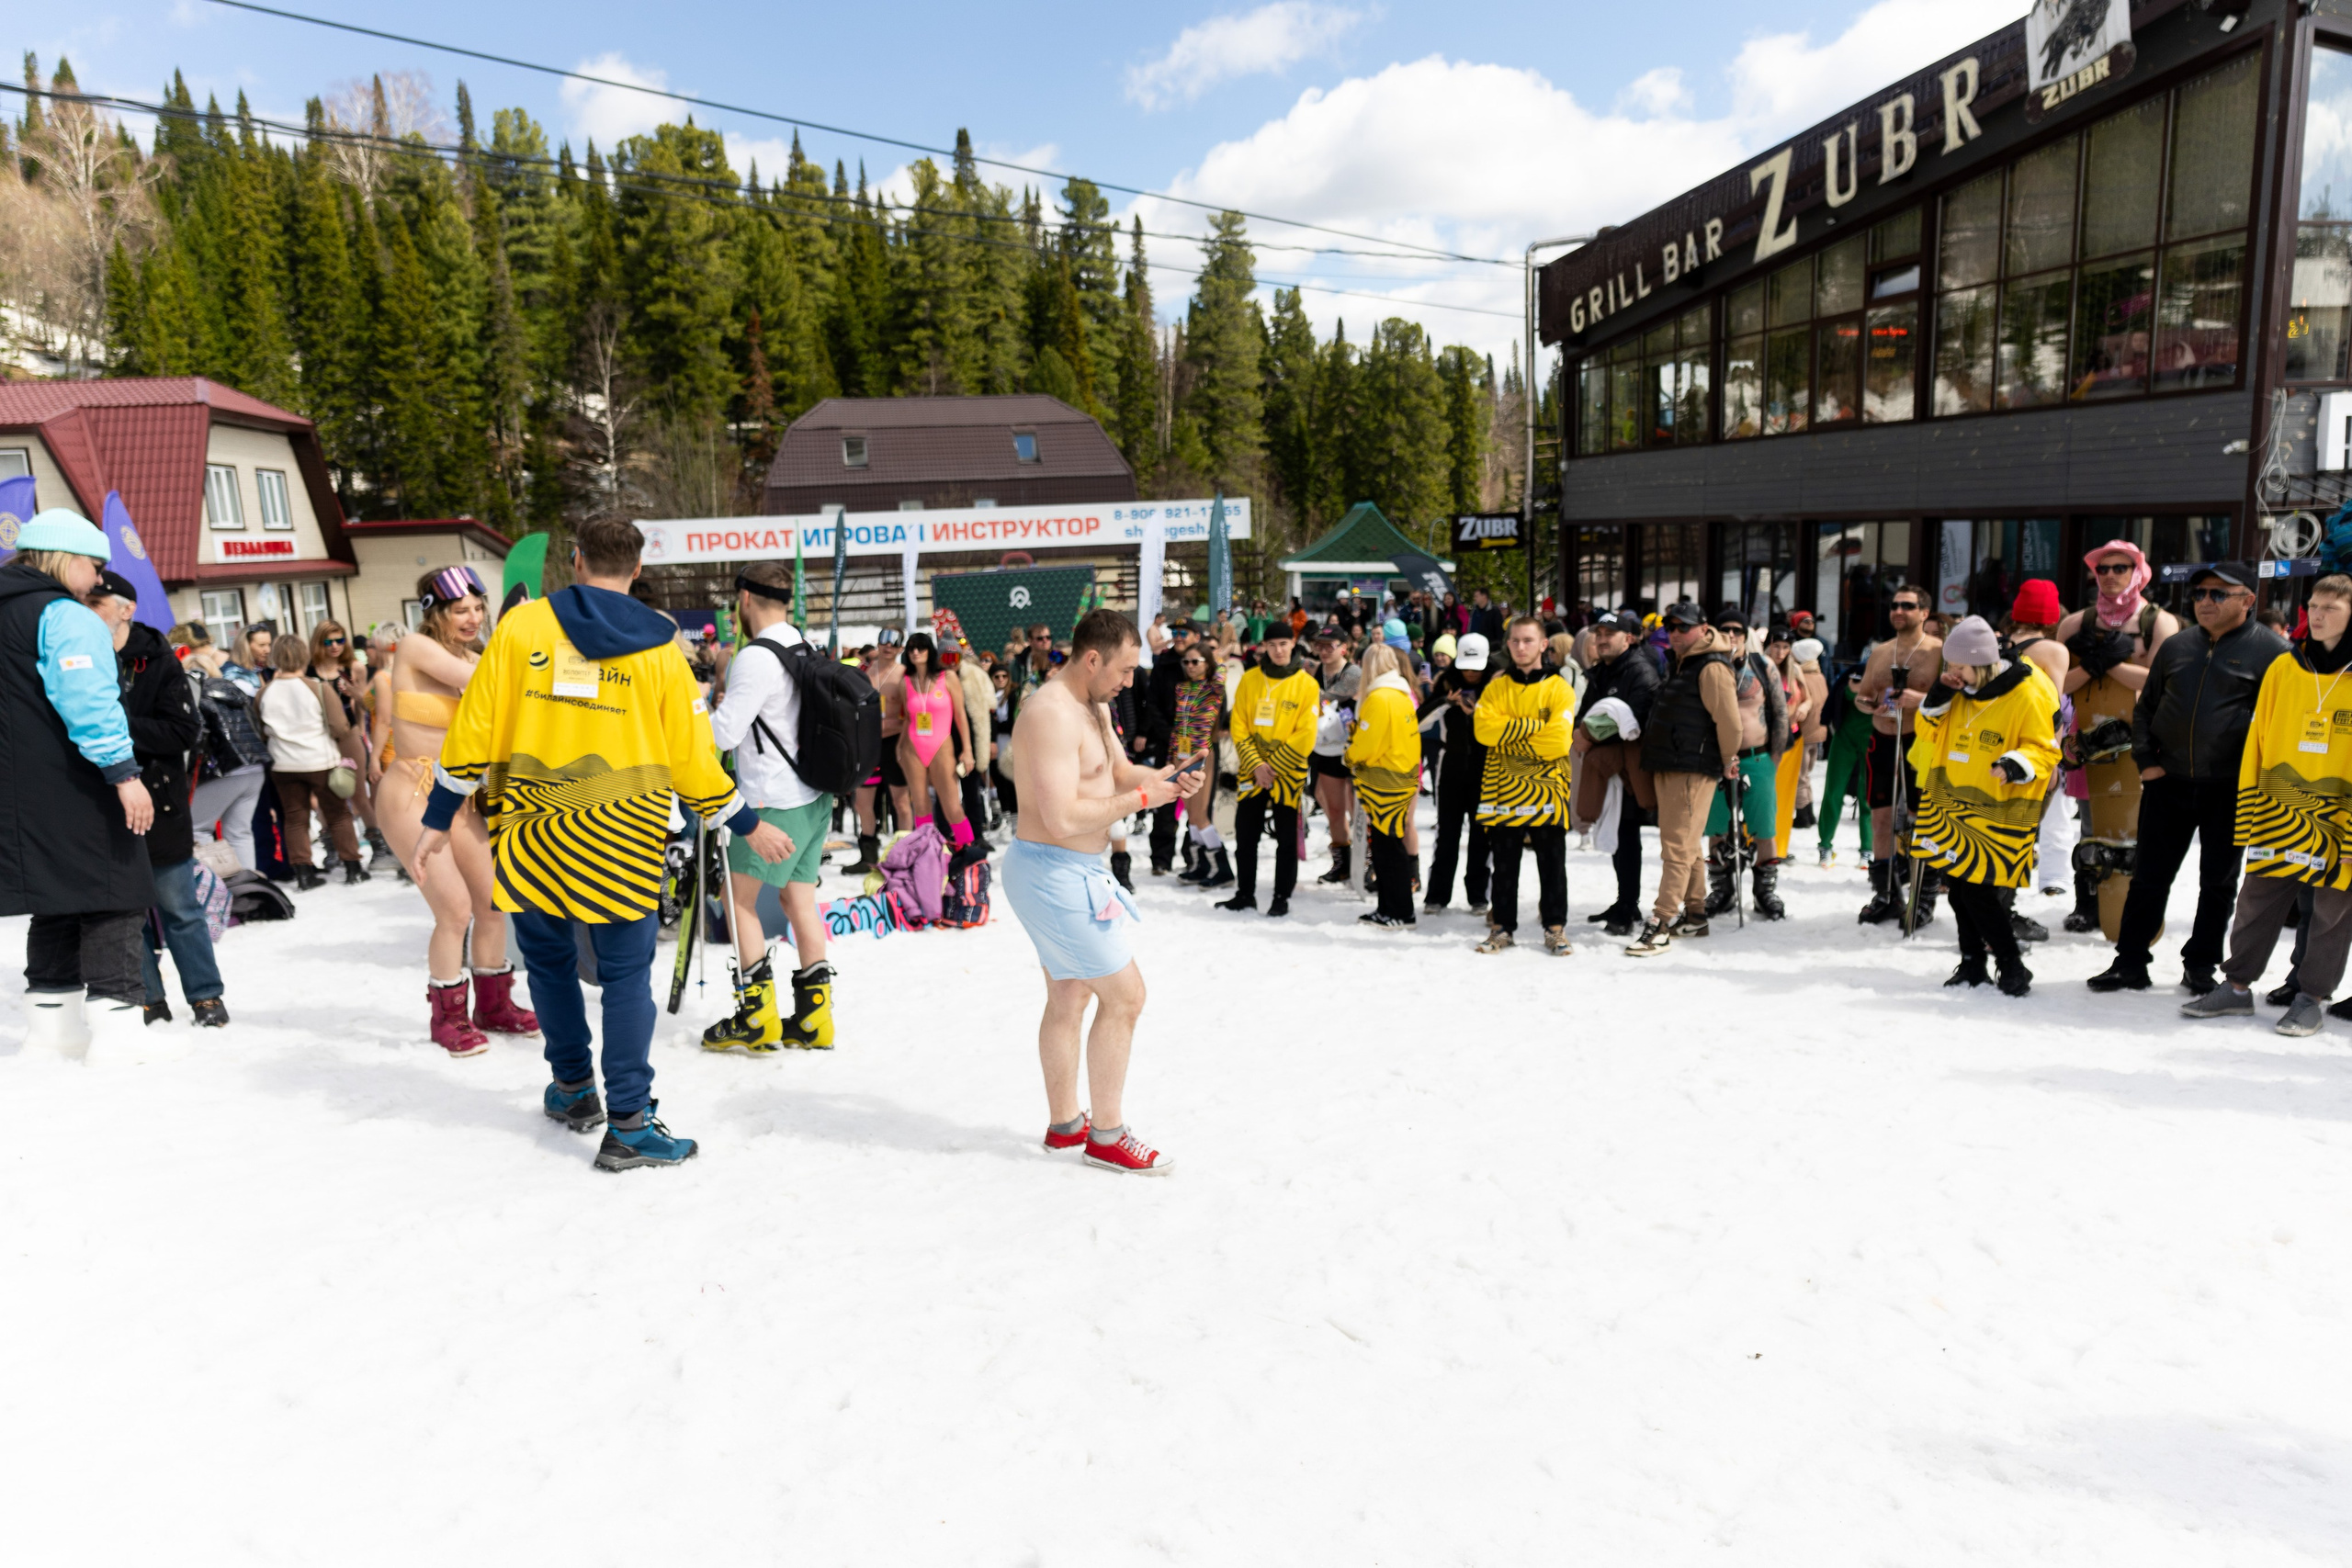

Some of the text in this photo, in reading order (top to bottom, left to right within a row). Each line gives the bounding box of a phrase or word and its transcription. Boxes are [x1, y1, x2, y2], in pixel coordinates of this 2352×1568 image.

[2041, 55, 2110, 110] ZUBR
[1570, 56, 1982, 333] GRILL BAR ZUBR
[686, 529, 794, 552] ПРОКАТ
[933, 516, 1101, 542] ИНСТРУКТОР
[1458, 516, 1519, 542] ZUBR
[525, 689, 627, 716] #билайнсоединяет
